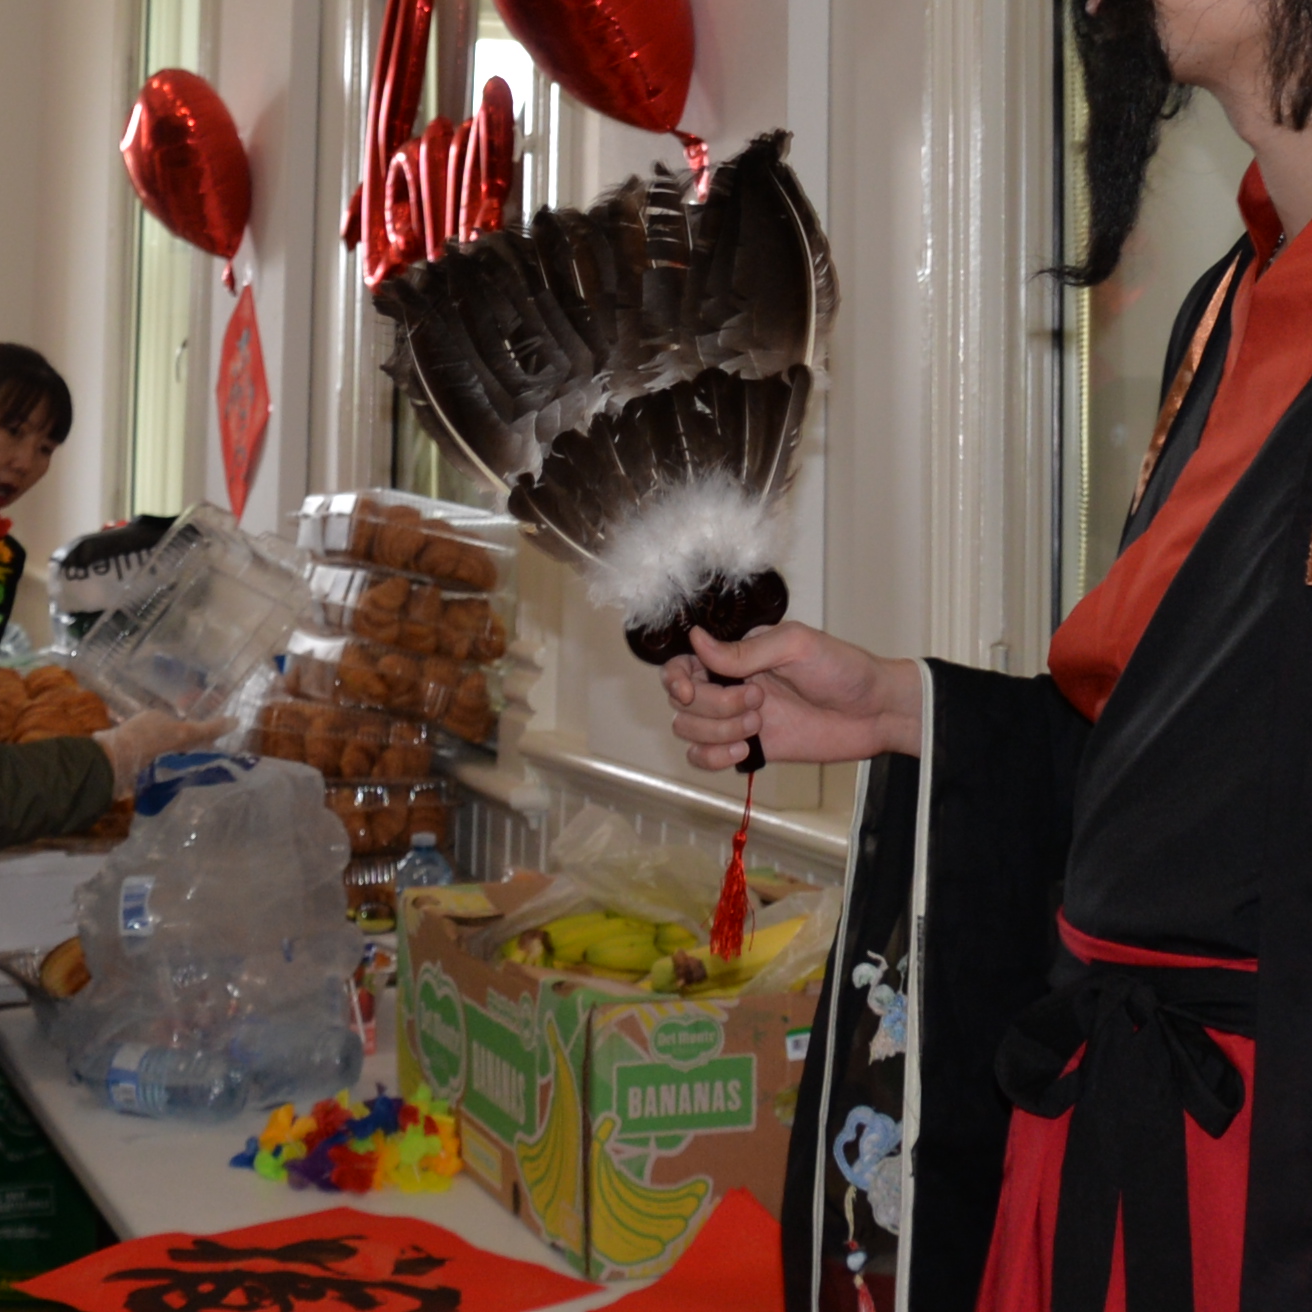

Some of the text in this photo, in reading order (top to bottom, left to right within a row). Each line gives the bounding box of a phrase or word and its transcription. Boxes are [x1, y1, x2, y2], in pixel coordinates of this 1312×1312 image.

[656, 1030, 716, 1047] Del Monte
[627, 1078, 743, 1120] BANANAS
